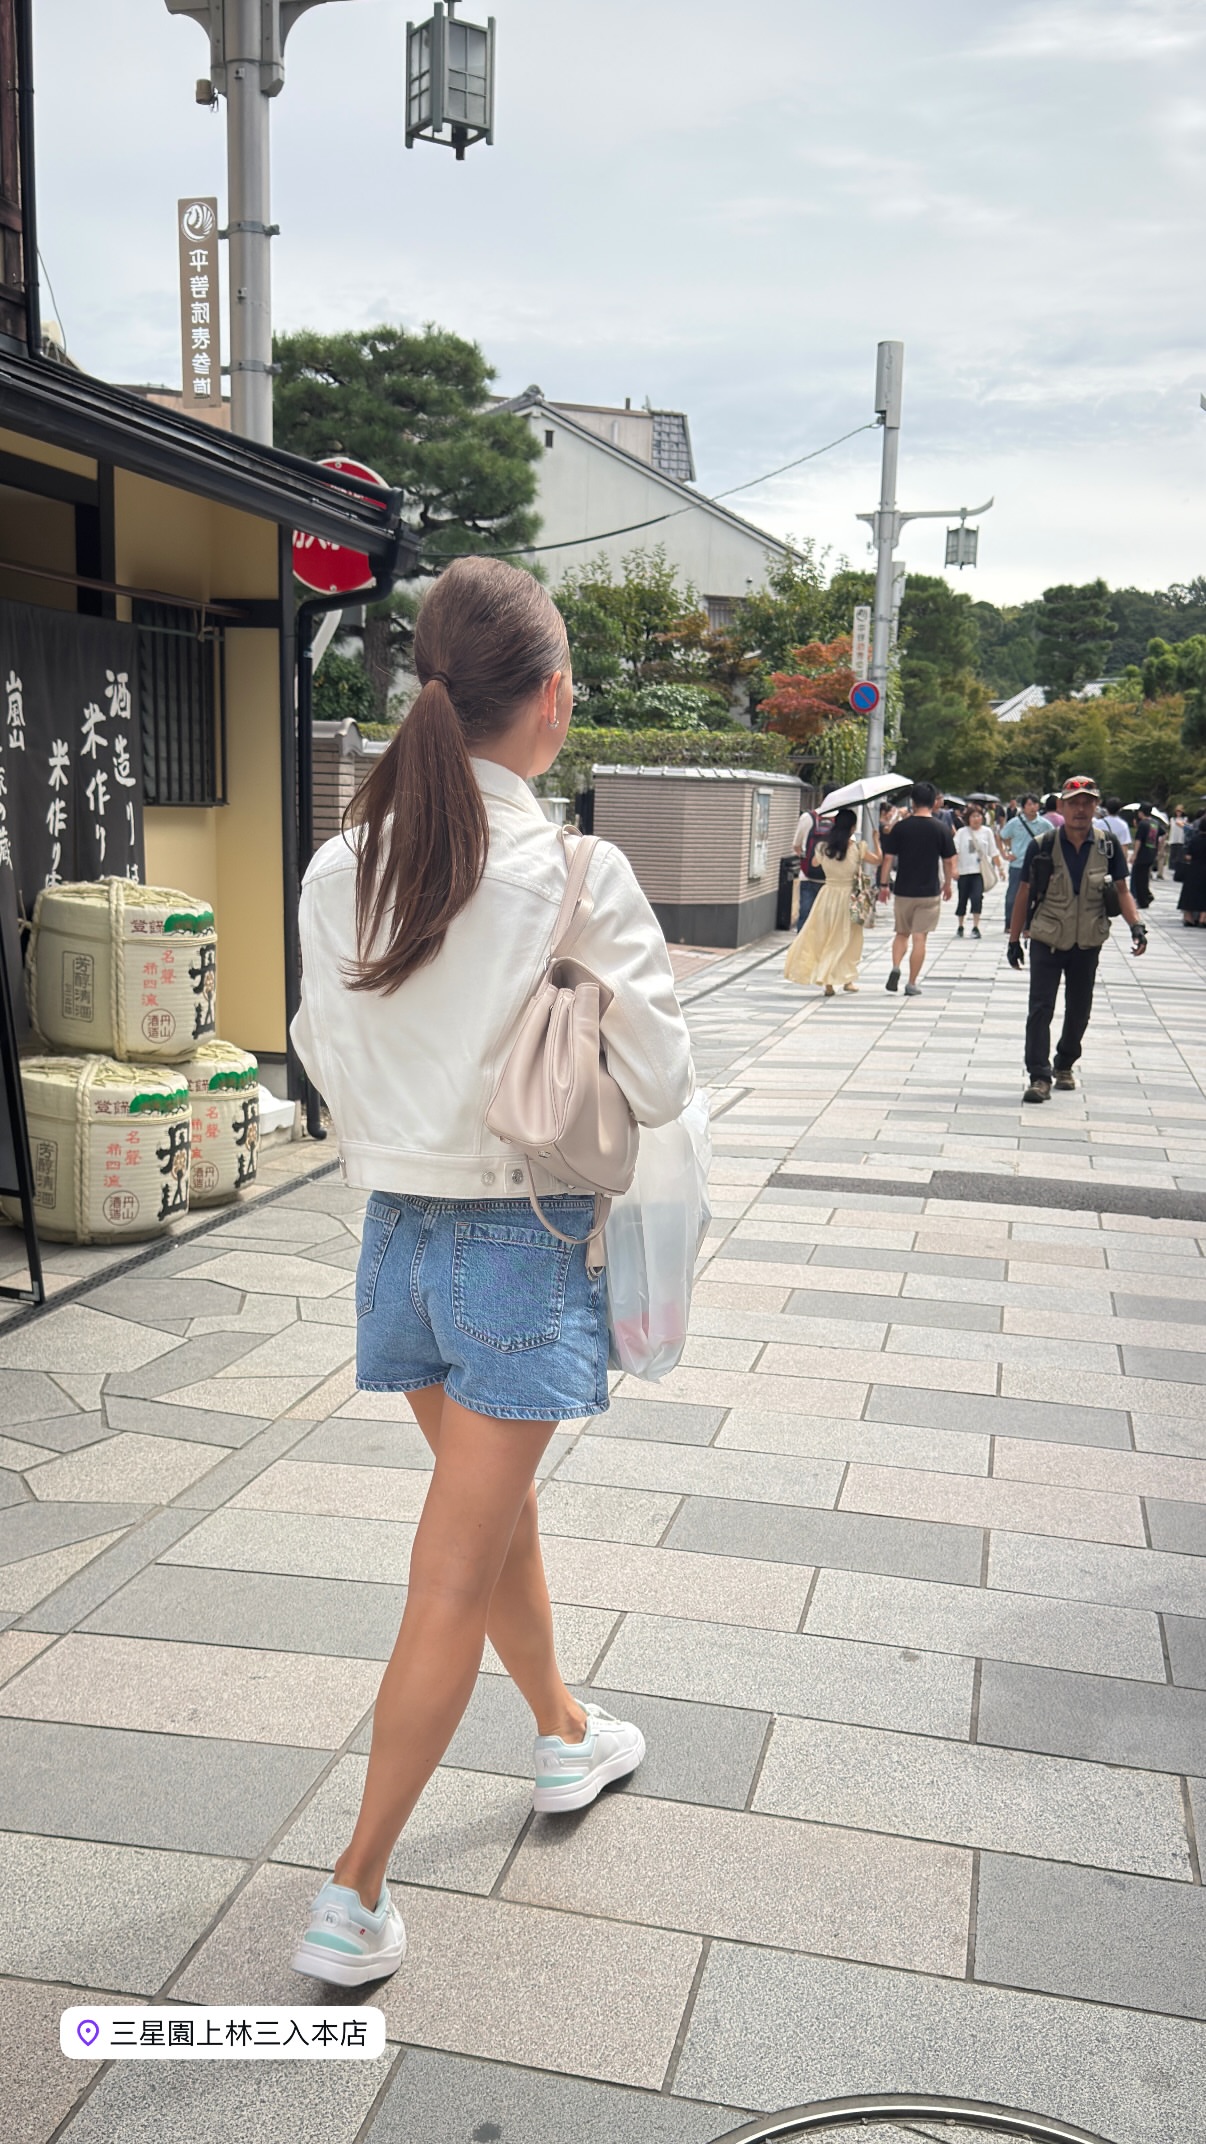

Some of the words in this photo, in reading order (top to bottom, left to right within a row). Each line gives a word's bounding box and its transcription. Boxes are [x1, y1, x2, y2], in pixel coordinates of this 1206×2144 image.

[6, 670, 26, 751] 嵐山
[80, 702, 110, 880] 米作り
